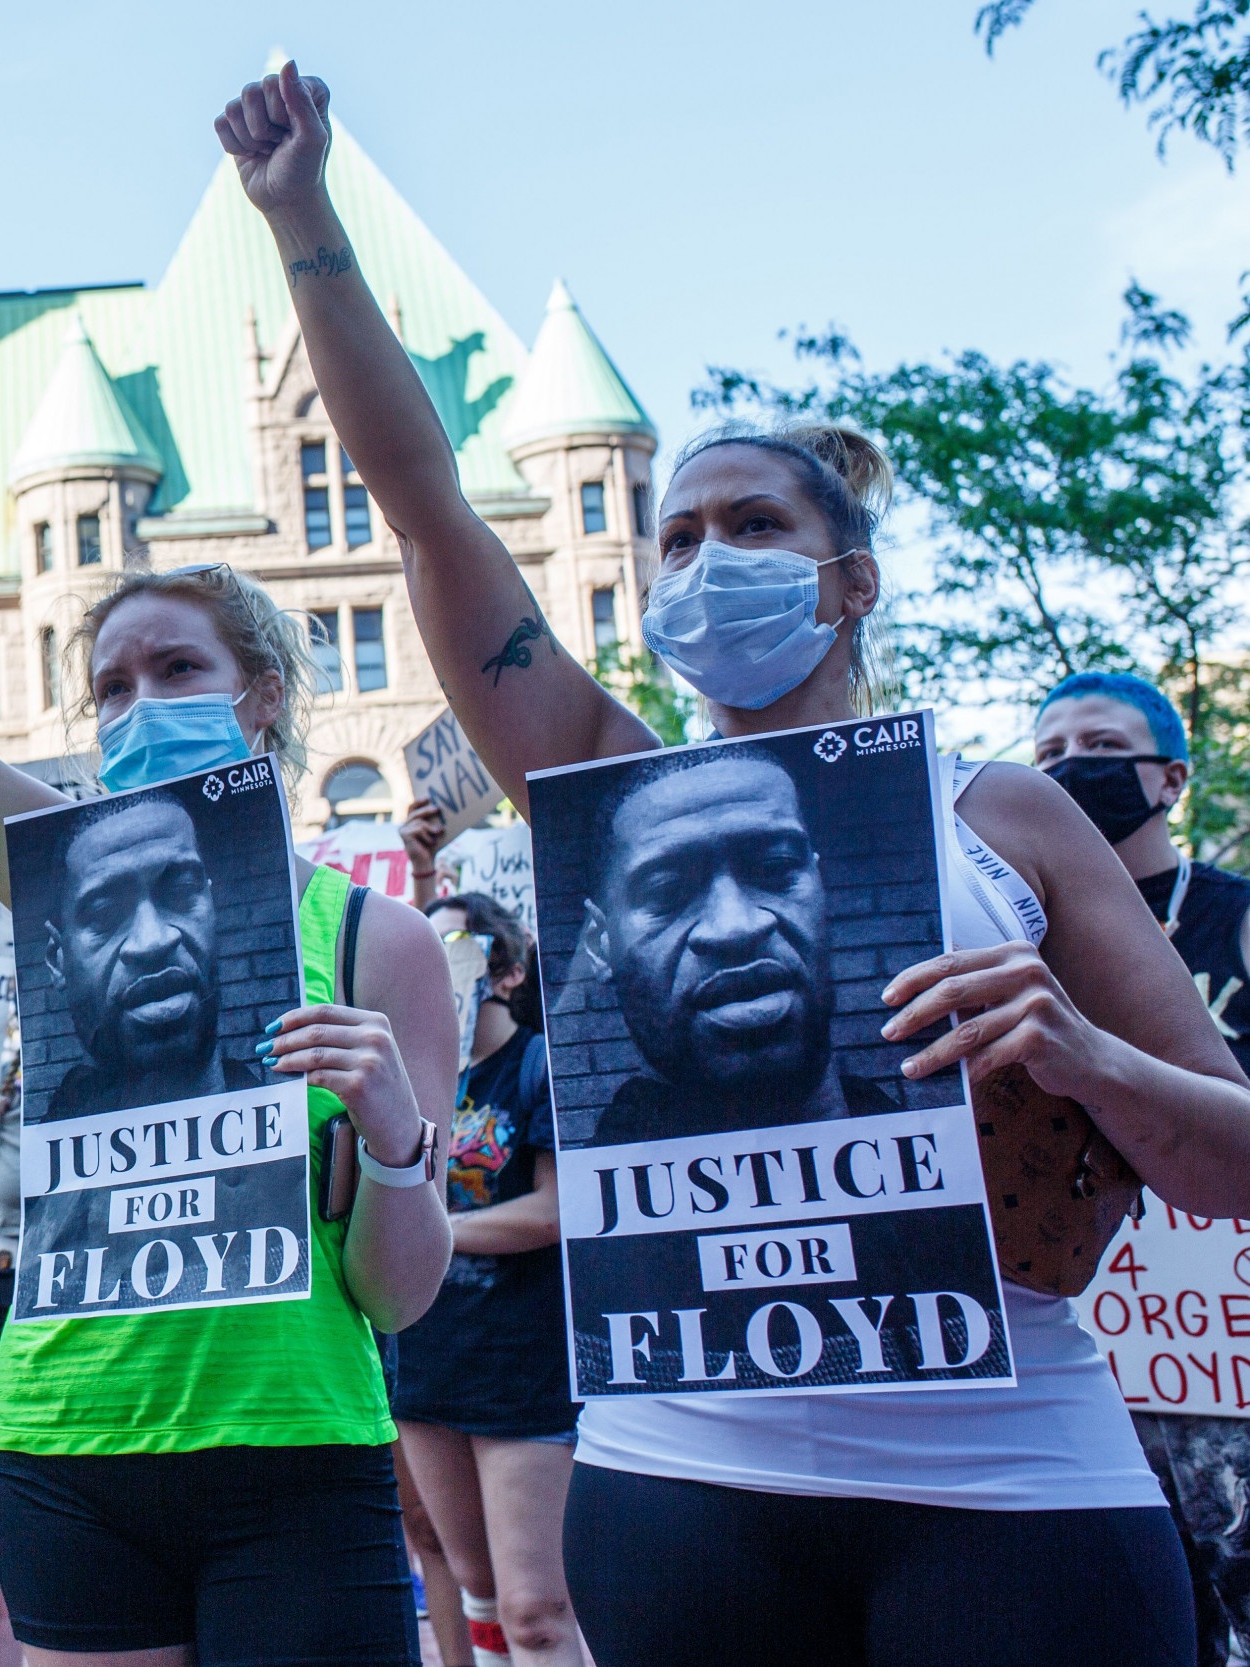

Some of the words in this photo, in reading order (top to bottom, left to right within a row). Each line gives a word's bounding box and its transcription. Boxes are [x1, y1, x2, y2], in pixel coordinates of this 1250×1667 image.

[416, 715, 460, 780] SAY
[854, 720, 919, 748] CAIR
[856, 741, 921, 757] MINNESOTA
[228, 762, 270, 788] CAIR
[230, 780, 274, 796] MINNESOTA
[967, 845, 1010, 881] NIKE
[1013, 897, 1046, 940] NIKE
[45, 1102, 282, 1194] JUSTICE
[594, 1133, 945, 1236] JUSTICE
[124, 1188, 201, 1226] FOR
[32, 1226, 300, 1310] FLOYD
[719, 1238, 835, 1281] FOR
[1108, 1242, 1148, 1292] 4
[1093, 1290, 1250, 1340] ORGE
[601, 1291, 991, 1385] FLOYD
